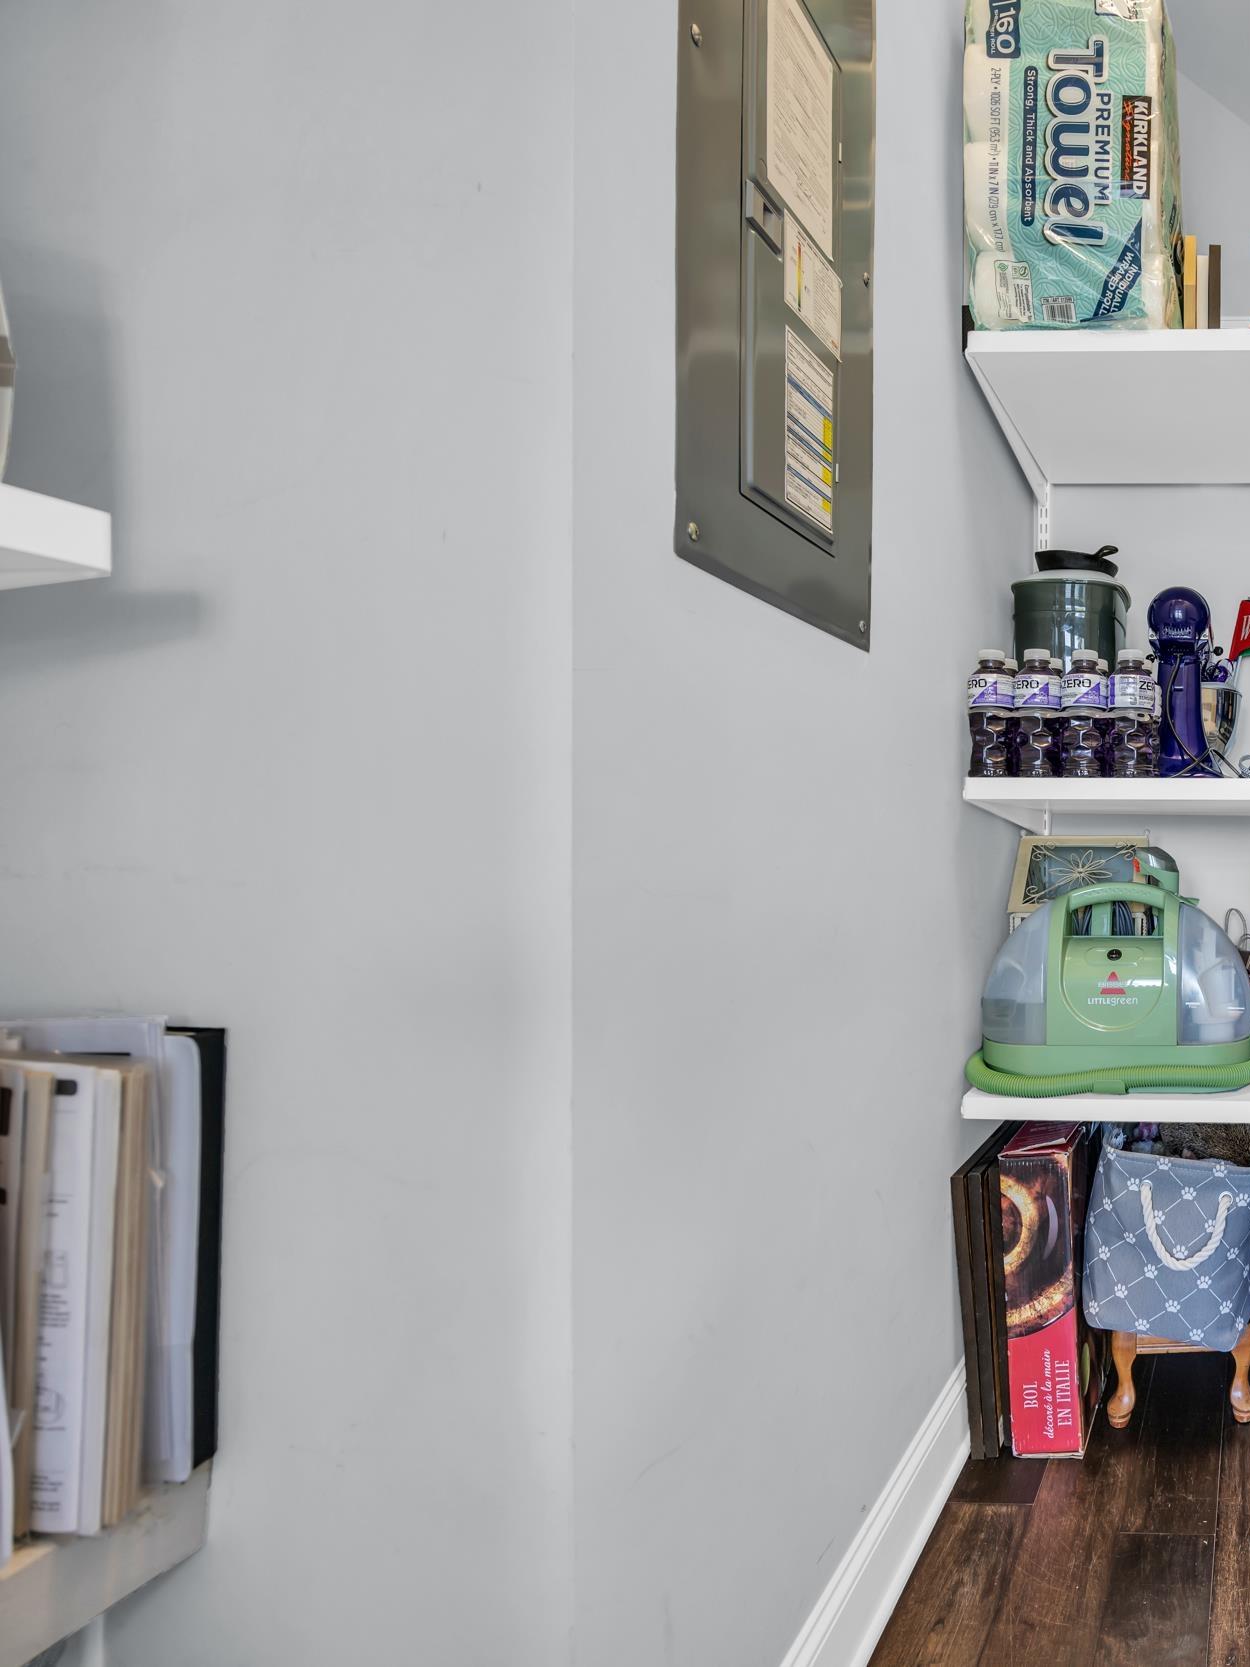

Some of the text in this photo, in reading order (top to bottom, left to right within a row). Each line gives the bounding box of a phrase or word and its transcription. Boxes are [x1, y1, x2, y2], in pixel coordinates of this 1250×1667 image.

[996, 7, 1016, 54] 160
[991, 68, 1001, 85] 2-PLY
[990, 107, 1001, 116] SQ
[990, 117, 1001, 126] FT
[1023, 69, 1036, 222] Strong, Thick and Absorbent
[1049, 40, 1104, 242] Towel
[1094, 92, 1111, 199] PREMIUM
[1133, 100, 1149, 195] KIRKLAND
[989, 187, 999, 195] IN
[968, 678, 987, 690] ERO
[1061, 678, 1092, 689] ZERO
[1023, 1380, 1038, 1409] BOL
[1040, 1348, 1055, 1439] décoré à la main
[1055, 1359, 1073, 1427] EN ITALIE
